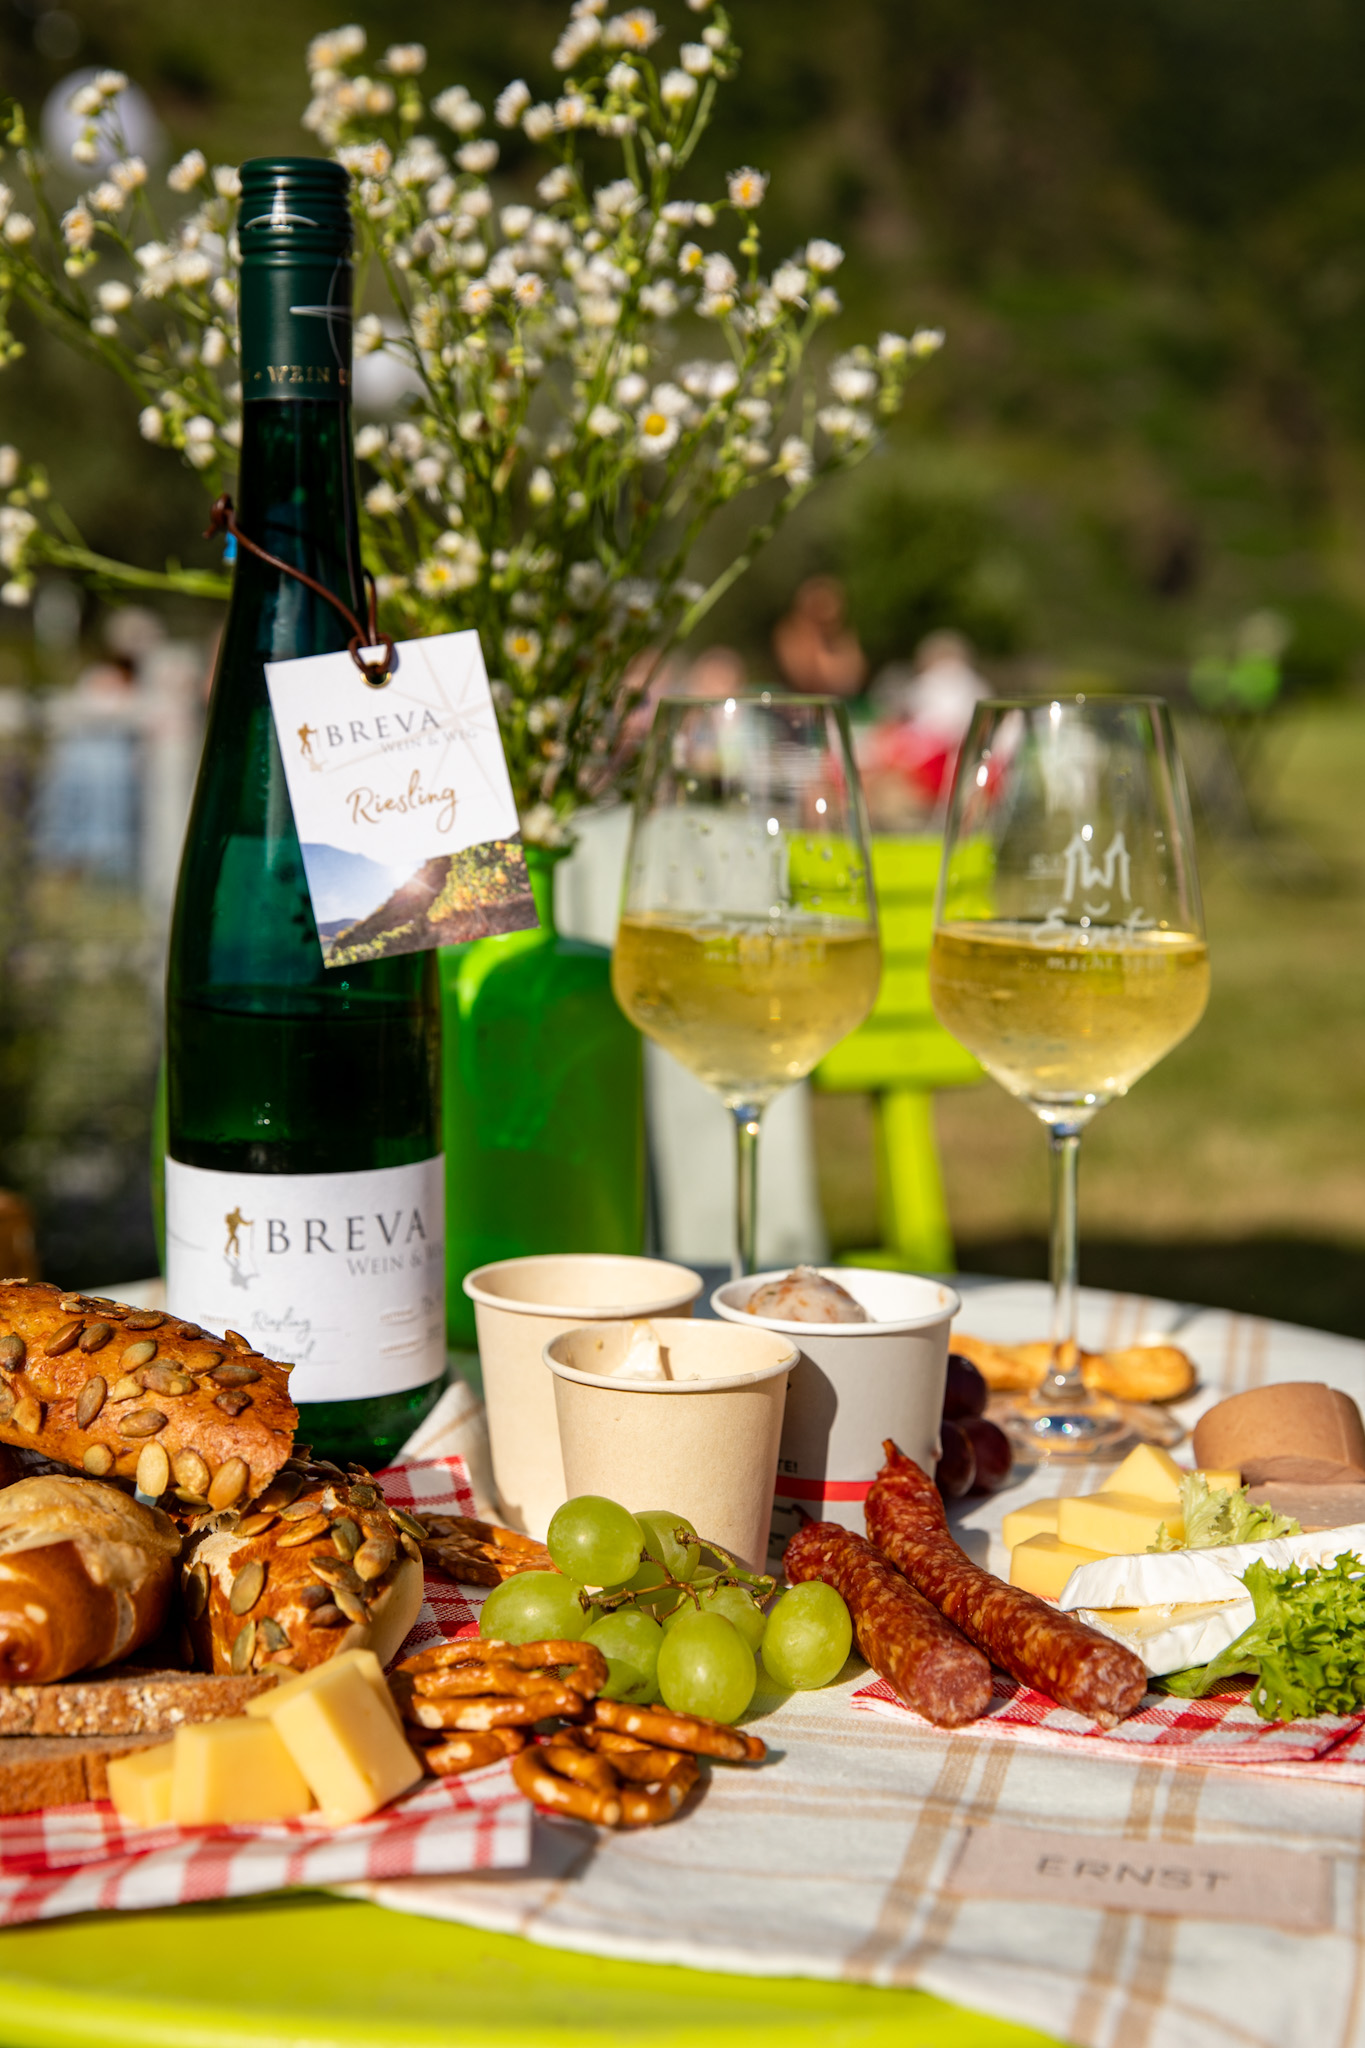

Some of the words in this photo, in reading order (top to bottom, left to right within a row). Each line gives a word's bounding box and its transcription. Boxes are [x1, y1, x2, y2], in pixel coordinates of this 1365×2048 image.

[266, 364, 331, 384] WEIN
[325, 709, 441, 748] BREVA
[379, 737, 423, 754] WEIN
[346, 769, 459, 834] Riesling
[266, 1207, 427, 1255] BREVA
[346, 1254, 405, 1277] WEIN
[1035, 1854, 1232, 1892] ERNST
